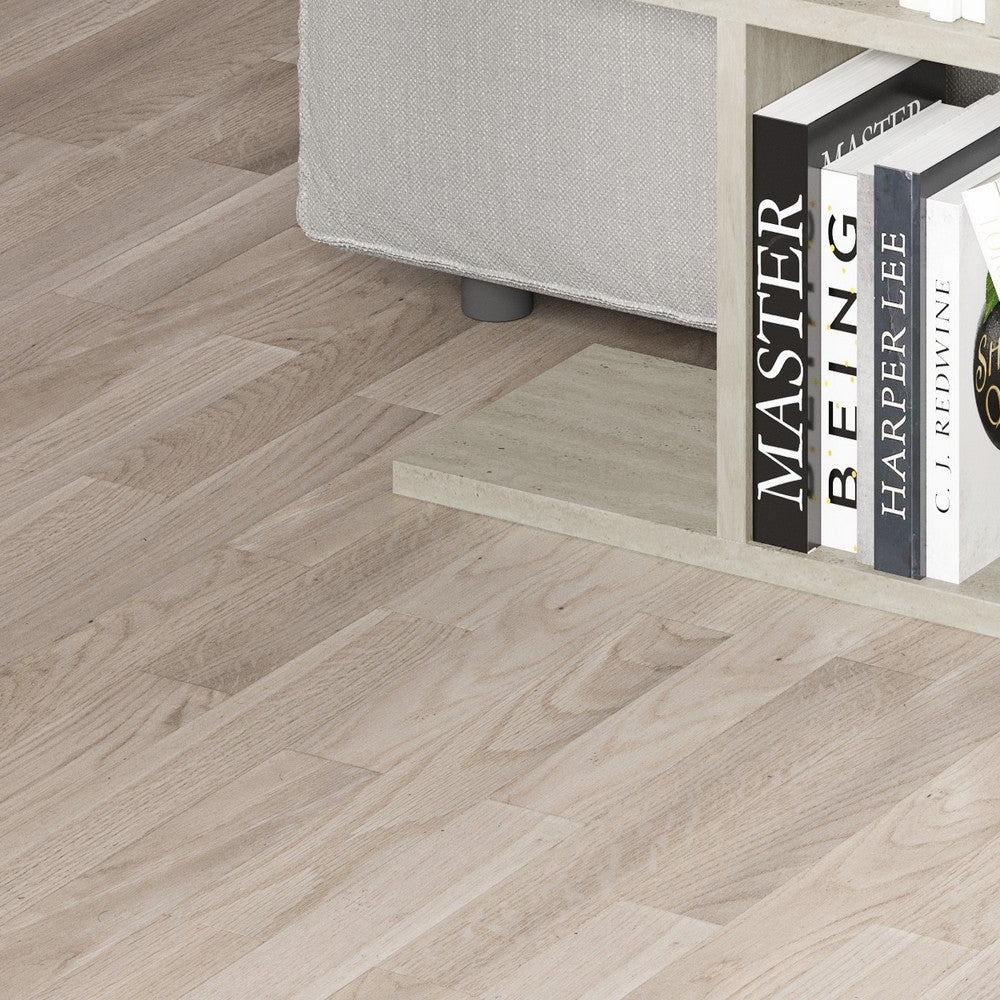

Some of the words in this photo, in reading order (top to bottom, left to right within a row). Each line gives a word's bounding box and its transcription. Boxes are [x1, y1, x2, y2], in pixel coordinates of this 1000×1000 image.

[881, 232, 906, 314] LEE
[756, 195, 803, 512] MASTER
[828, 214, 857, 510] BEING
[881, 327, 906, 520] HARPER
[935, 279, 950, 436] REDWINE
[935, 455, 951, 472] J.
[935, 488, 950, 513] C.
